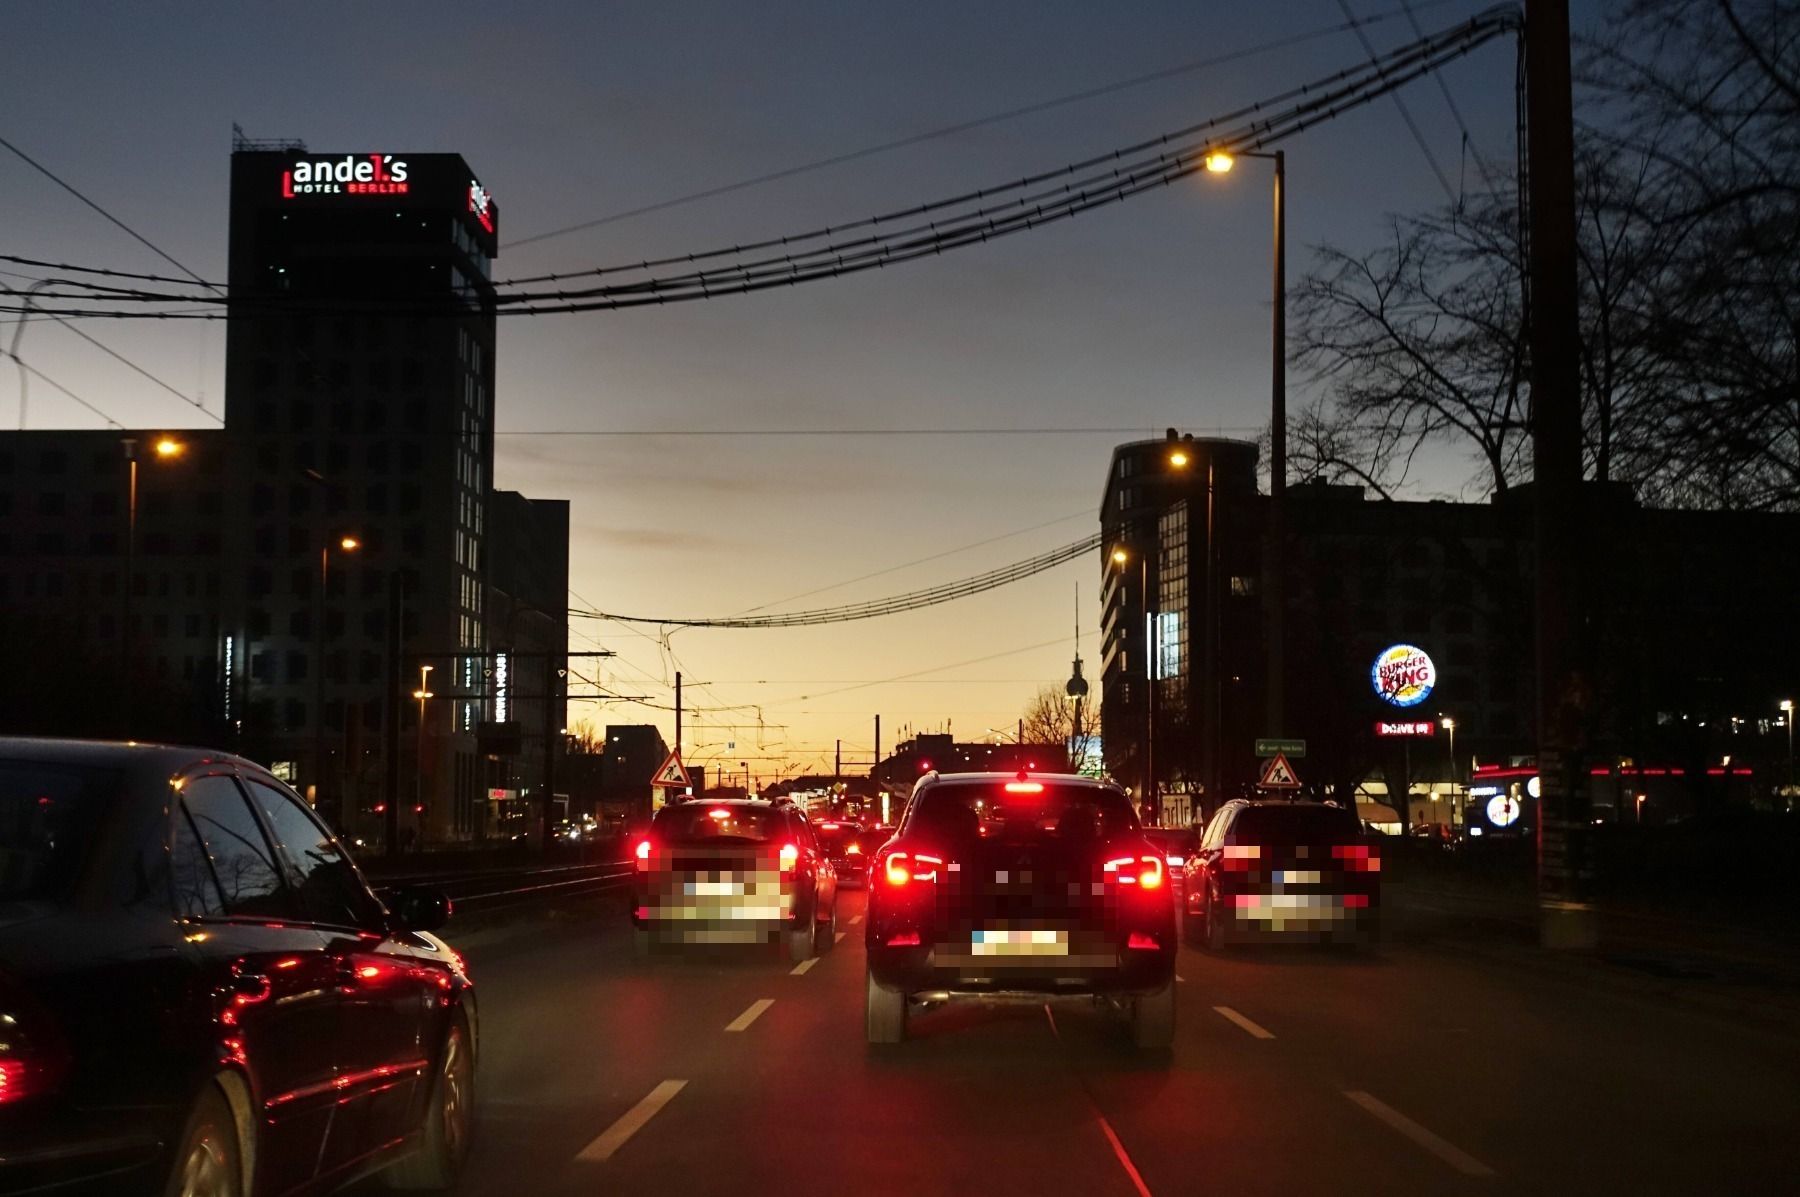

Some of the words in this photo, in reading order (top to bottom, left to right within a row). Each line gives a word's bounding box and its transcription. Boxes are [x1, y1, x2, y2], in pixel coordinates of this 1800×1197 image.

[293, 184, 341, 193] HOTEL
[347, 183, 408, 194] BERLIN
[1379, 656, 1426, 678] BURGER
[1381, 667, 1429, 693] KING
[495, 688, 506, 723] IENNA
